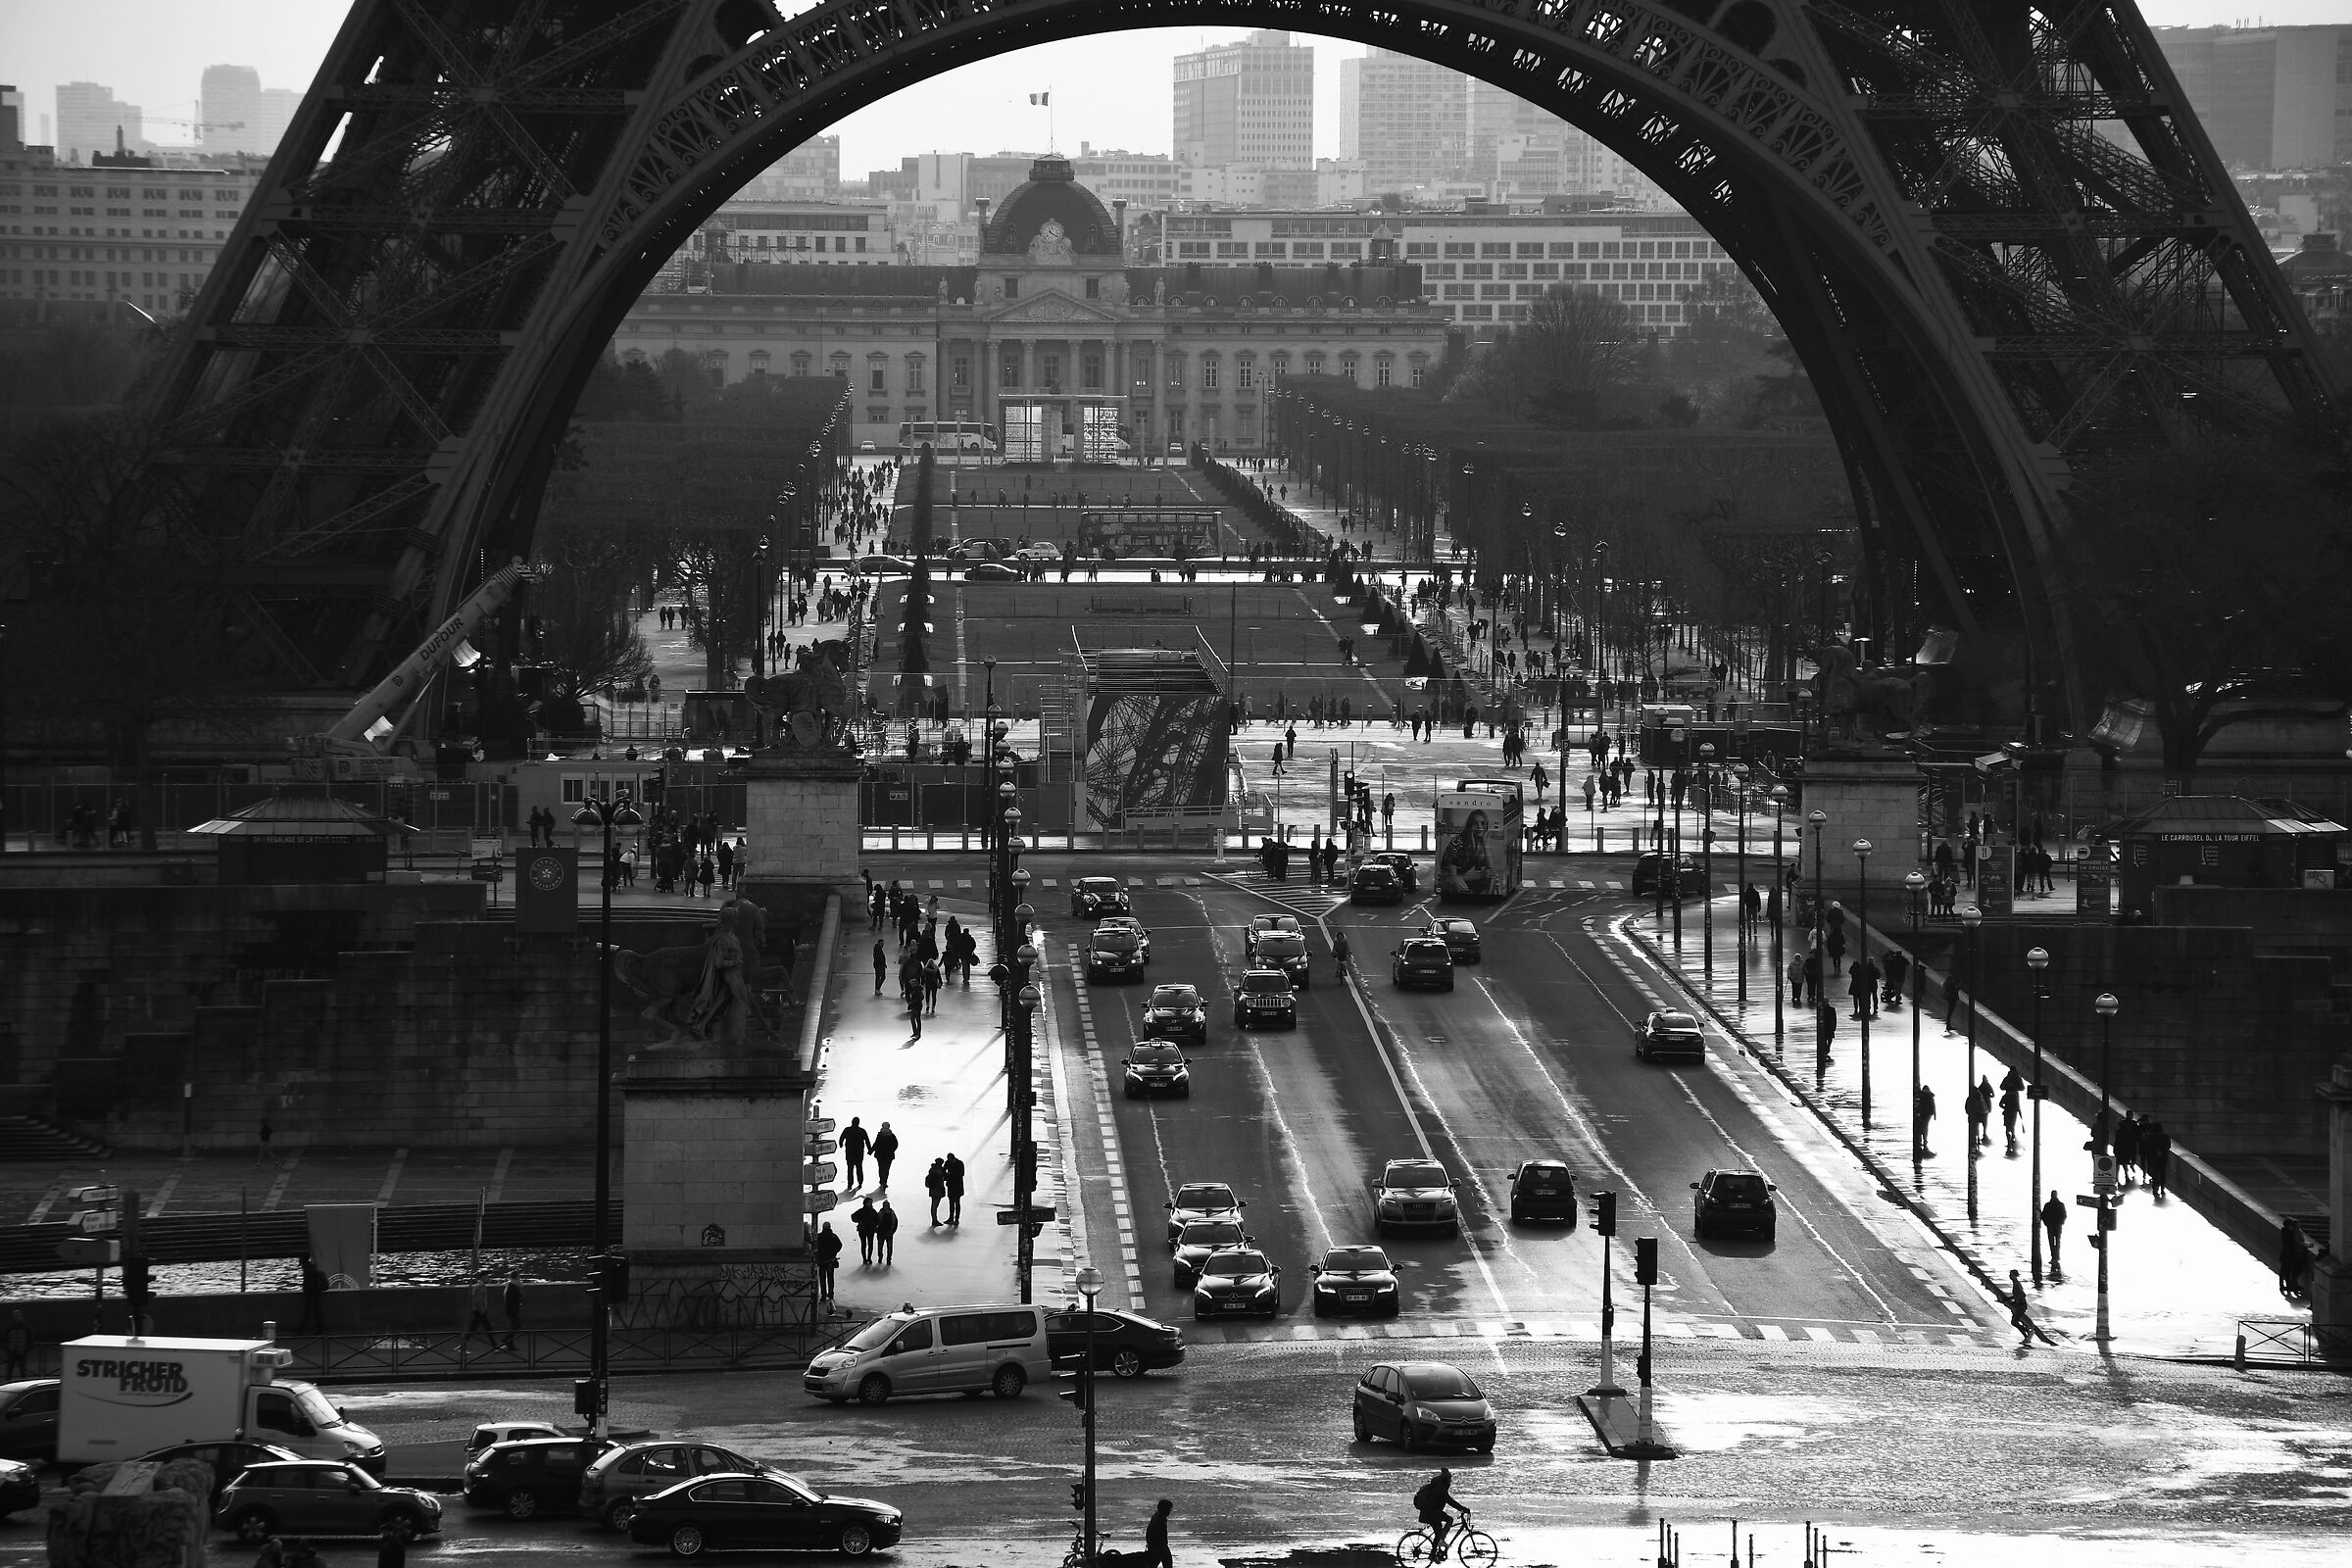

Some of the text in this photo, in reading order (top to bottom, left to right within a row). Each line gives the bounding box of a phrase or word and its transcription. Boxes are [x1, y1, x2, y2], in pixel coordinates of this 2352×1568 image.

[419, 617, 464, 661] DUFOUR
[76, 1358, 183, 1380] STRICHER
[120, 1376, 188, 1394] FROID
